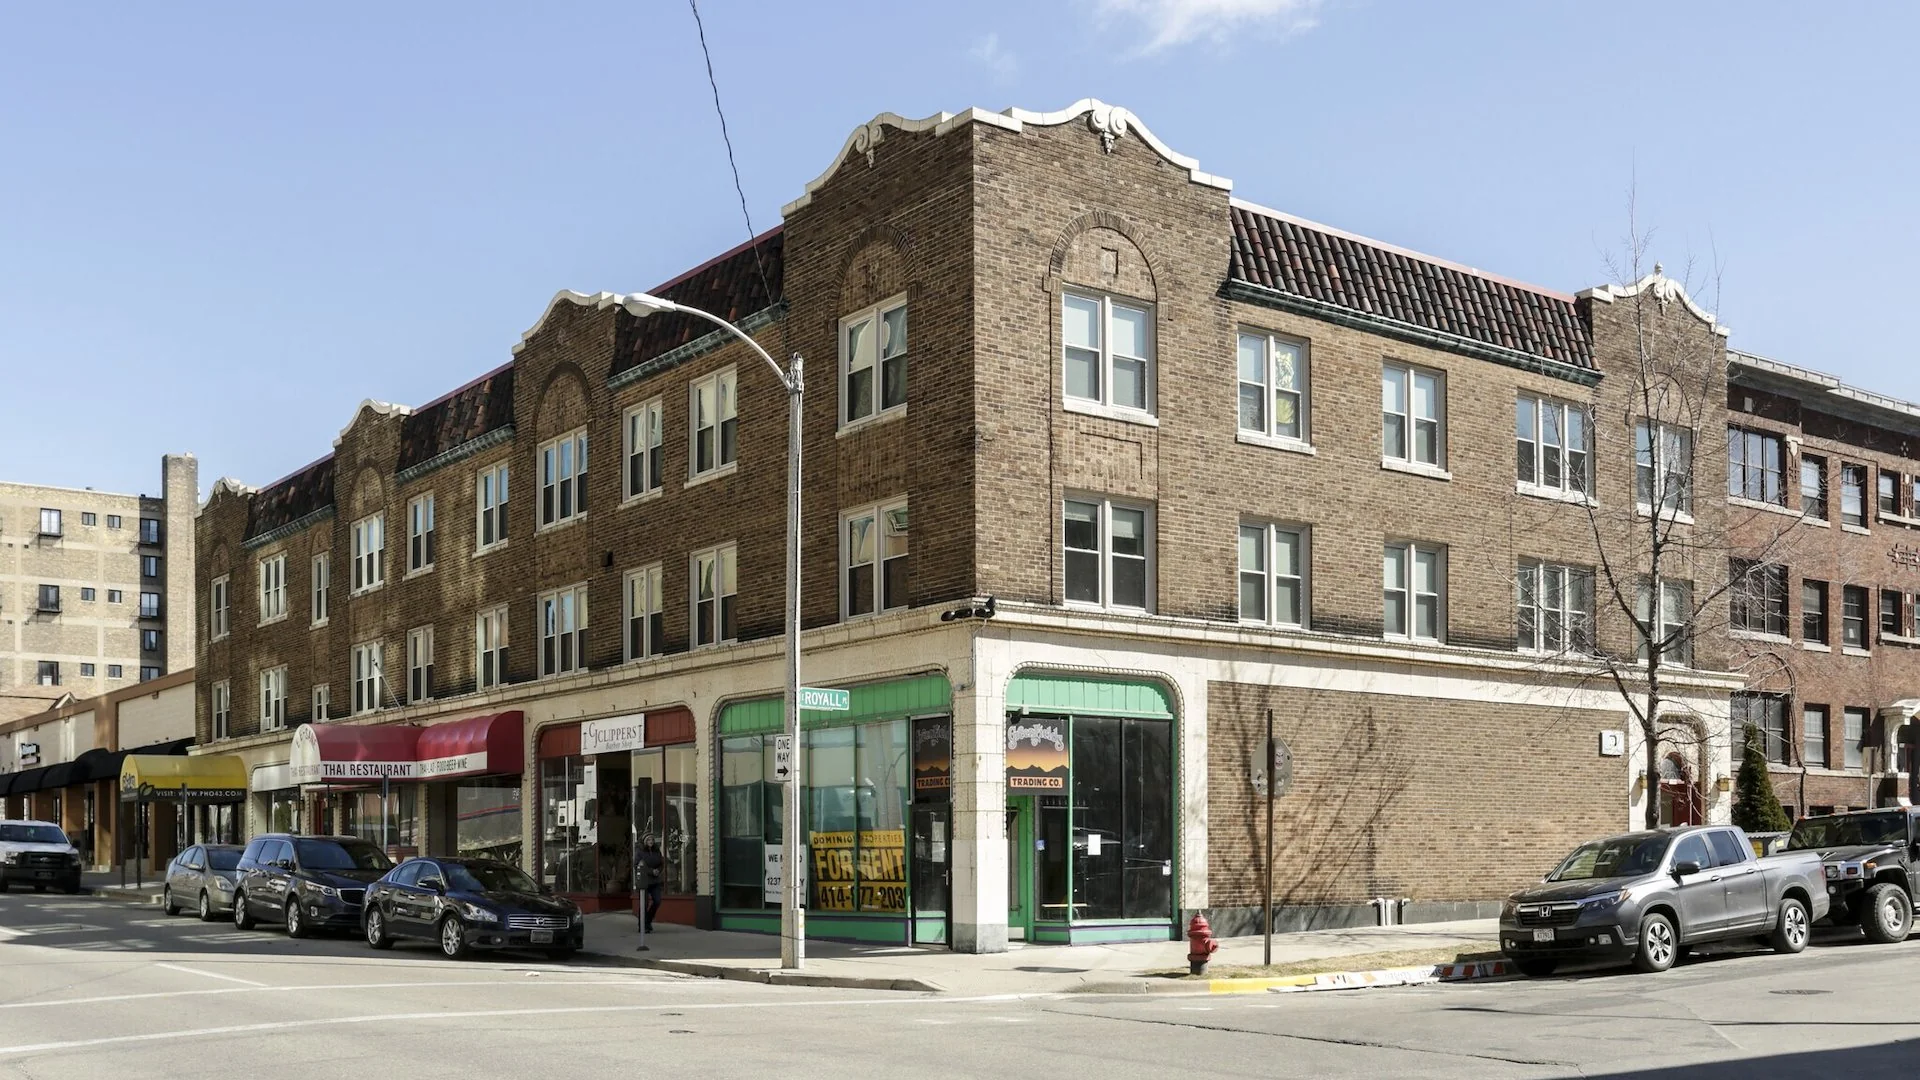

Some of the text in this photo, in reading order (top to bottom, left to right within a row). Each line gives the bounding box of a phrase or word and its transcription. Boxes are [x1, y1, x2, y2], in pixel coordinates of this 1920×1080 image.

[805, 691, 841, 706] ROYALL
[605, 740, 633, 750] Barber Shop
[777, 739, 790, 750] ONE
[777, 752, 790, 762] WAY
[323, 764, 412, 776] THAI RESTAURANT
[917, 778, 943, 788] TRADING
[1012, 778, 1061, 787] TRADING CO.
[813, 835, 854, 844] DOMINIO
[768, 854, 779, 863] WE
[815, 849, 905, 881] FOR RENT
[767, 877, 781, 886] 1237
